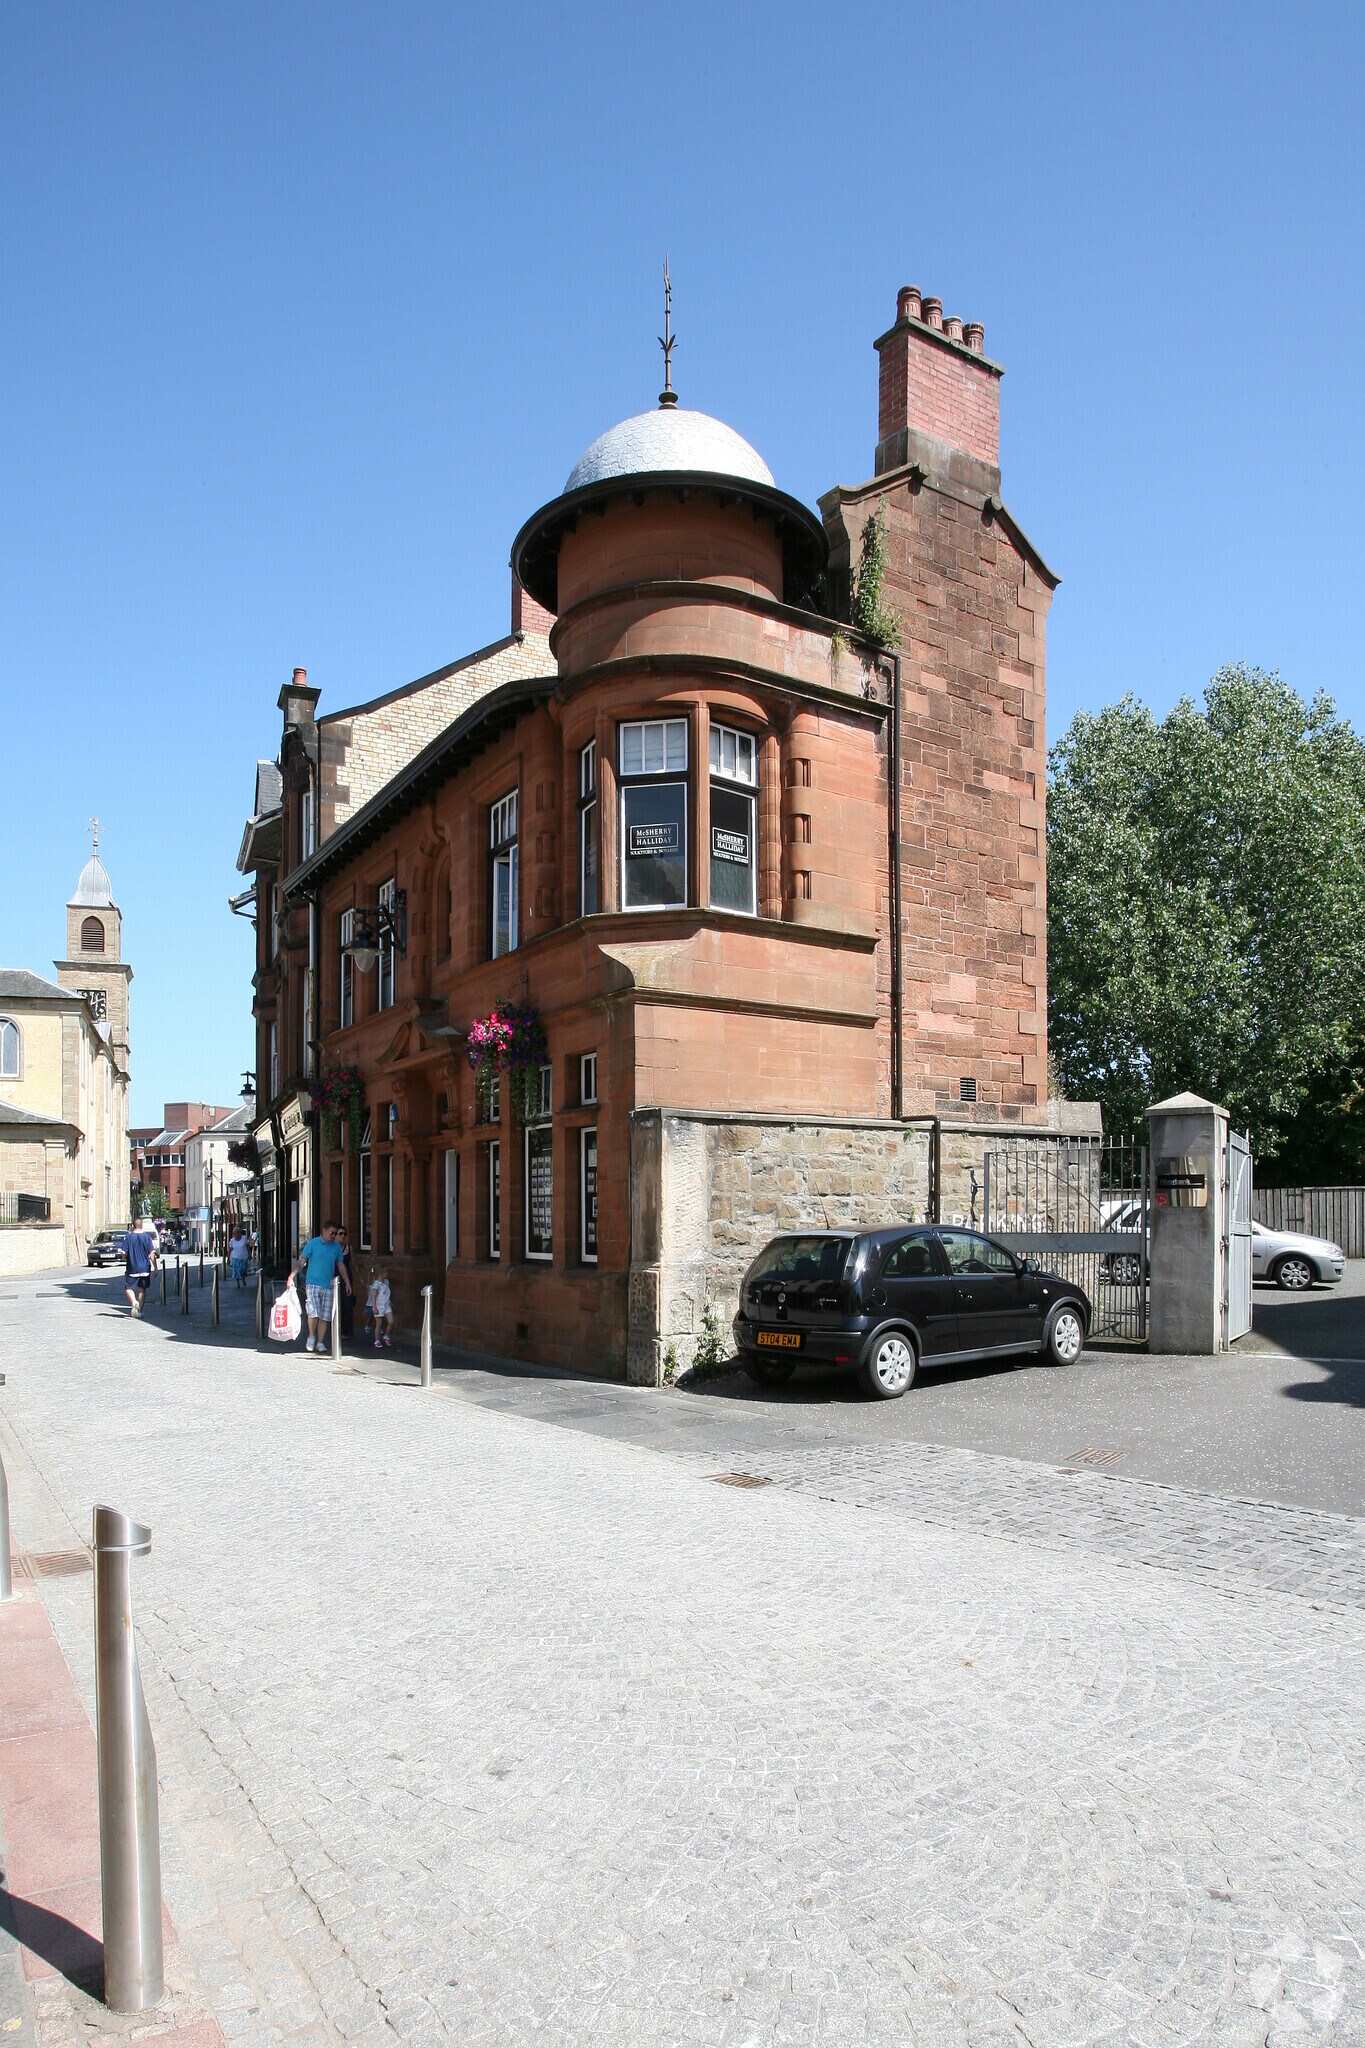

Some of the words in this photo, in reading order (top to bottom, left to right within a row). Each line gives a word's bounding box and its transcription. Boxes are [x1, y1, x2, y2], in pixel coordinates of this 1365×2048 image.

[636, 827, 672, 836] McSHERRY
[636, 836, 672, 846] HALLIDAY
[717, 832, 744, 845] McSHERRY
[717, 841, 744, 854] HALLIDAY
